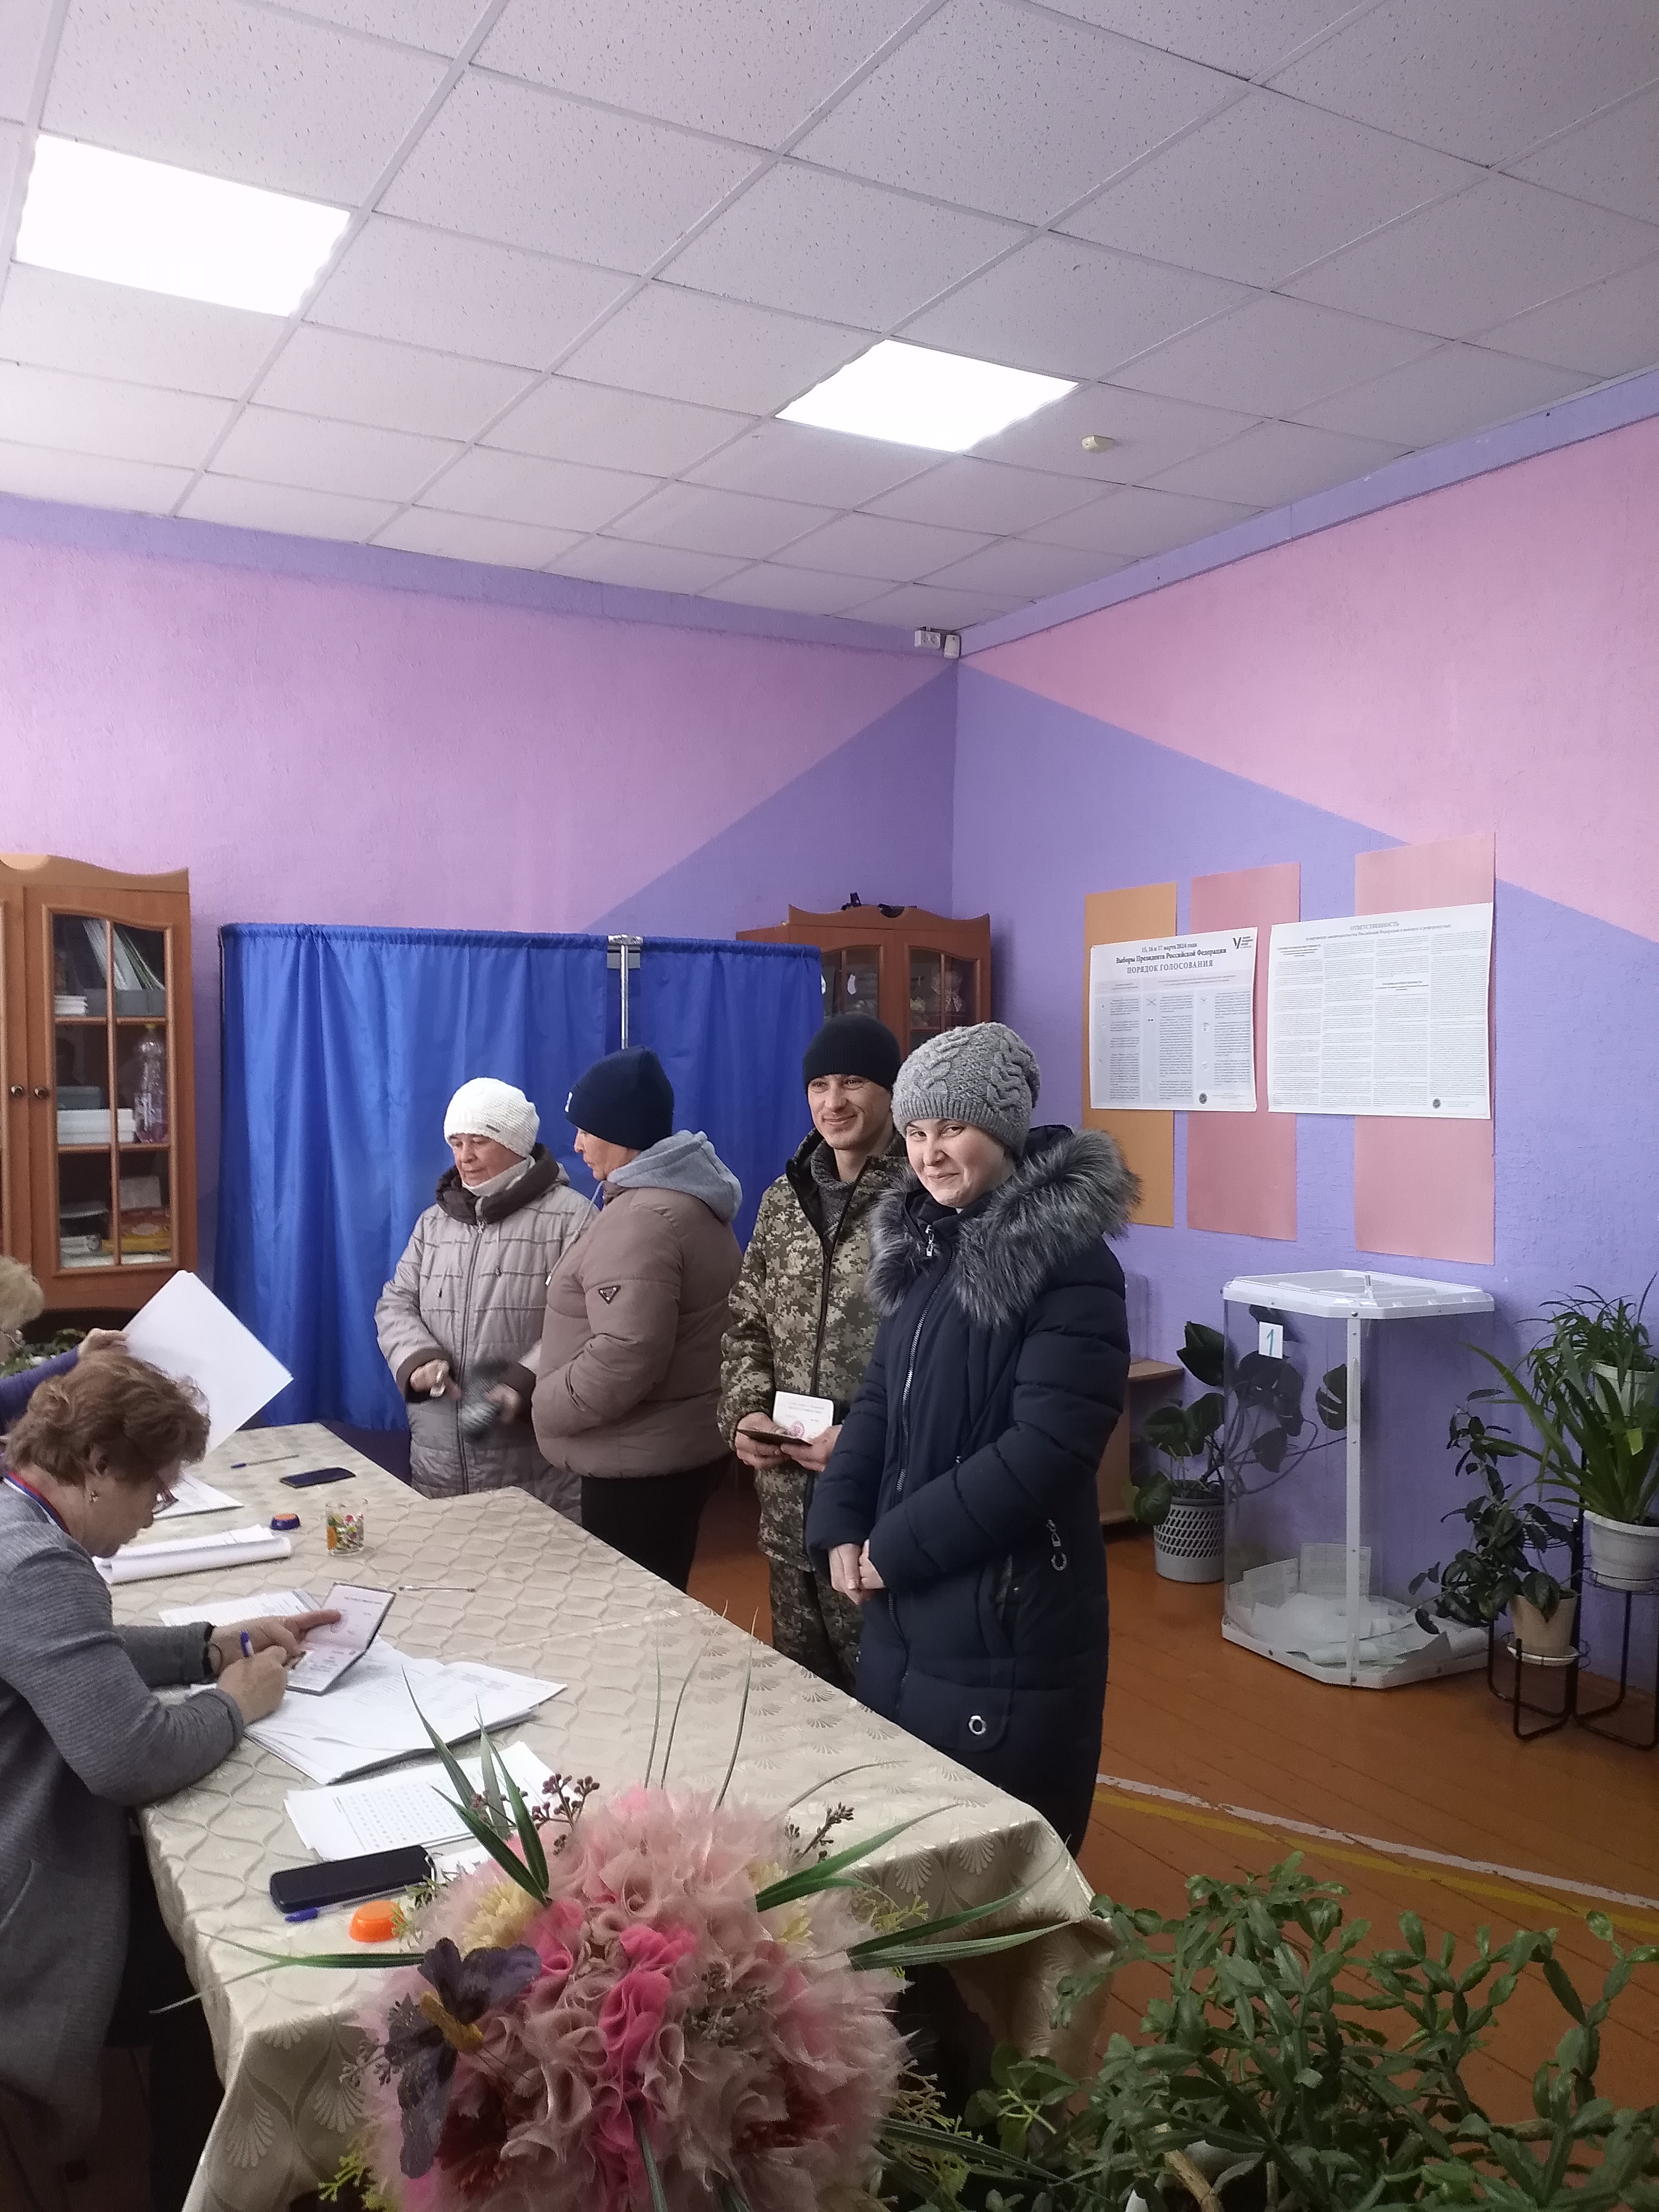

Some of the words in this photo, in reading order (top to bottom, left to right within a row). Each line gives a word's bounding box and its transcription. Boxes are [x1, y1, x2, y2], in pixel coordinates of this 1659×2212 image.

[1136, 954, 1165, 963] Президента
[1166, 950, 1196, 959] Российской
[1196, 948, 1227, 957] Федерации
[1127, 965, 1158, 974] ПОРЯДОК
[1160, 959, 1213, 971] ГОЛОСОВАНИЯ
[1267, 1329, 1274, 1355] 1
